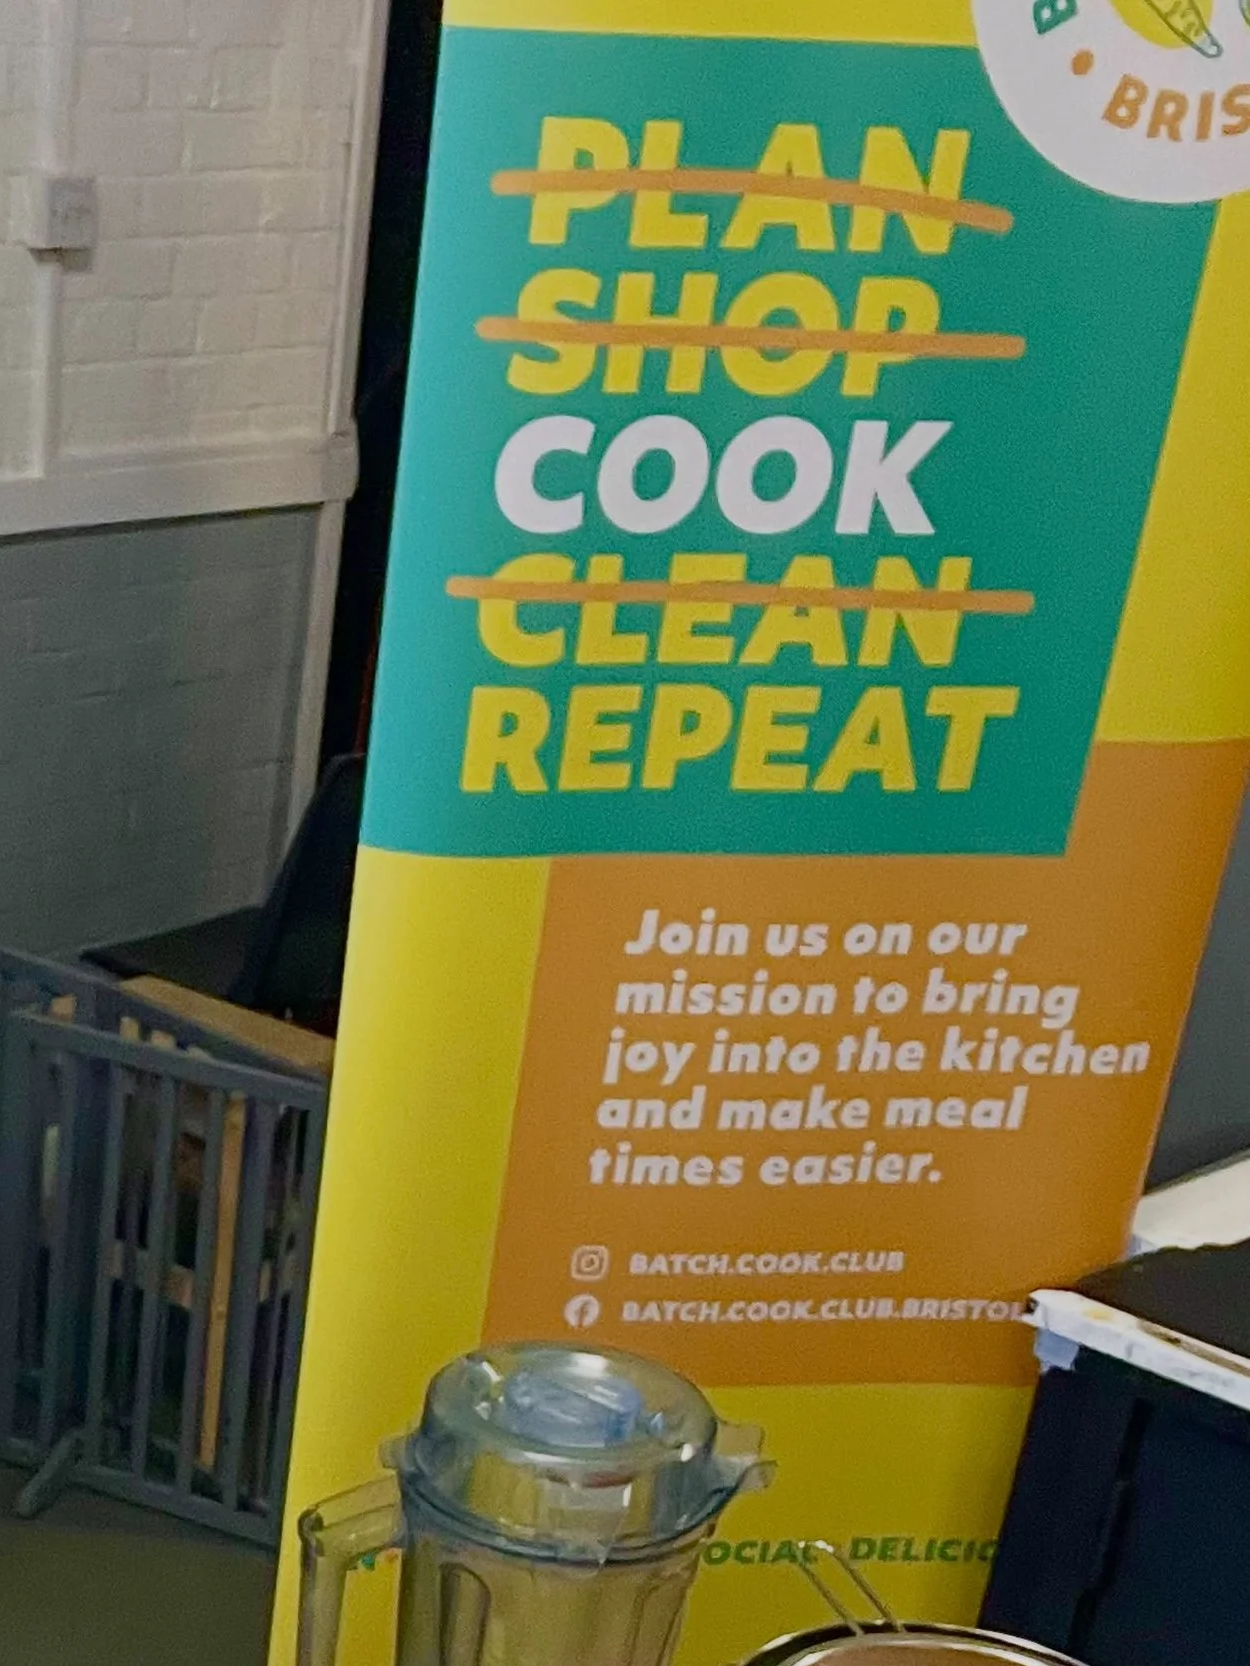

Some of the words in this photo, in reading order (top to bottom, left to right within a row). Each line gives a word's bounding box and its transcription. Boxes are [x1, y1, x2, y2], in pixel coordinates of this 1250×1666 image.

[527, 116, 972, 254] PLAN
[506, 268, 941, 397] SHOP
[494, 414, 953, 536] COOK
[478, 553, 973, 669] CLEAN
[460, 684, 1020, 794] REPEAT
[624, 907, 750, 956] Join
[764, 923, 830, 957] us
[843, 922, 912, 956] on
[926, 921, 1028, 956] our
[614, 967, 837, 1016] mission
[852, 976, 909, 1015] to
[921, 966, 1081, 1030] bring
[602, 1026, 697, 1086] joy
[707, 1027, 822, 1075] into
[836, 1025, 925, 1073] the
[939, 1025, 1151, 1076] kitchen
[597, 1084, 708, 1130] and
[716, 1083, 871, 1132] make
[884, 1084, 1029, 1131] meal
[588, 1140, 744, 1186] times
[758, 1139, 942, 1186] easier.
[628, 1250, 905, 1276] BATCH.COOK.CLUB
[702, 1539, 819, 1565] OCIAL
